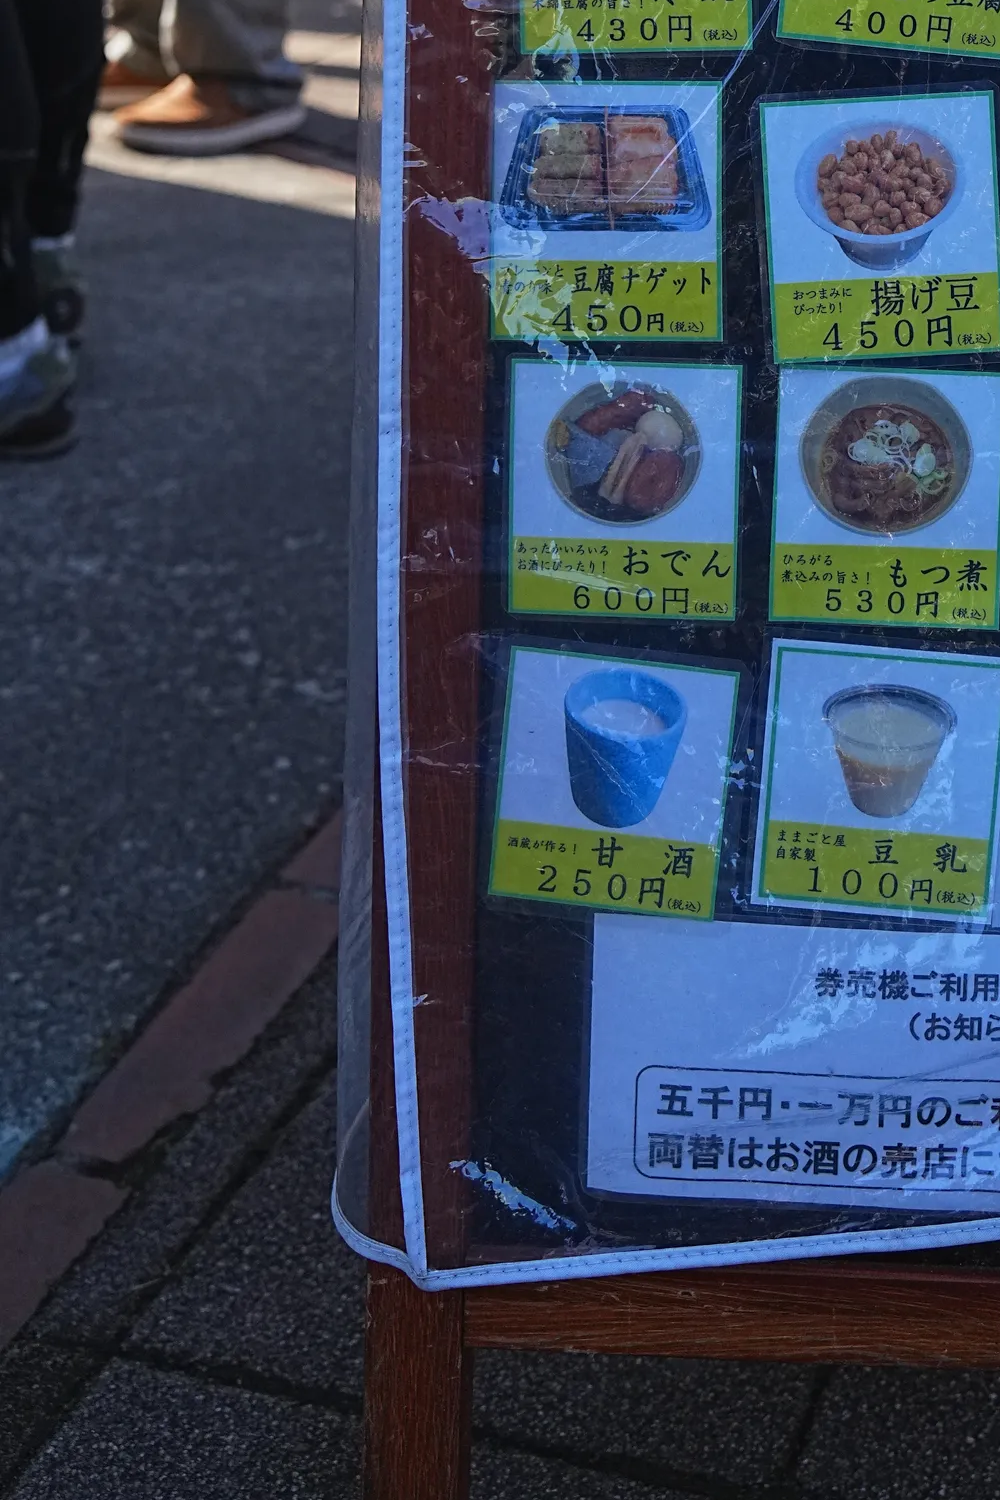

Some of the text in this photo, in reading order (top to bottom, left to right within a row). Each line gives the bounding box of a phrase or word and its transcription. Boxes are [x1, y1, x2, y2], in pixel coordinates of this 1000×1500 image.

[576, 15, 738, 43] 430円 (税込)
[835, 9, 996, 47] 400円 (税込)
[571, 263, 711, 296] 豆腐ナゲット
[793, 288, 852, 300] おつまみに
[871, 276, 980, 317] 揚げ豆
[552, 304, 704, 333] 450円 (税込)
[822, 315, 992, 350] 450円 (税込)
[623, 546, 731, 578] おでん
[782, 554, 833, 566] ひろがる
[890, 558, 988, 592] もつ煮
[781, 571, 871, 585] 煮込みの旨さ！
[573, 585, 729, 614] 600円 (税込)
[825, 588, 987, 620] 530円 (税込)
[776, 845, 817, 862] 自家製
[777, 829, 847, 848] ままごと屋
[591, 836, 695, 879] 甘酒
[868, 839, 968, 874] 豆乳
[538, 865, 701, 913] 250円 (税込)
[808, 866, 976, 906] 100円 (税込)
